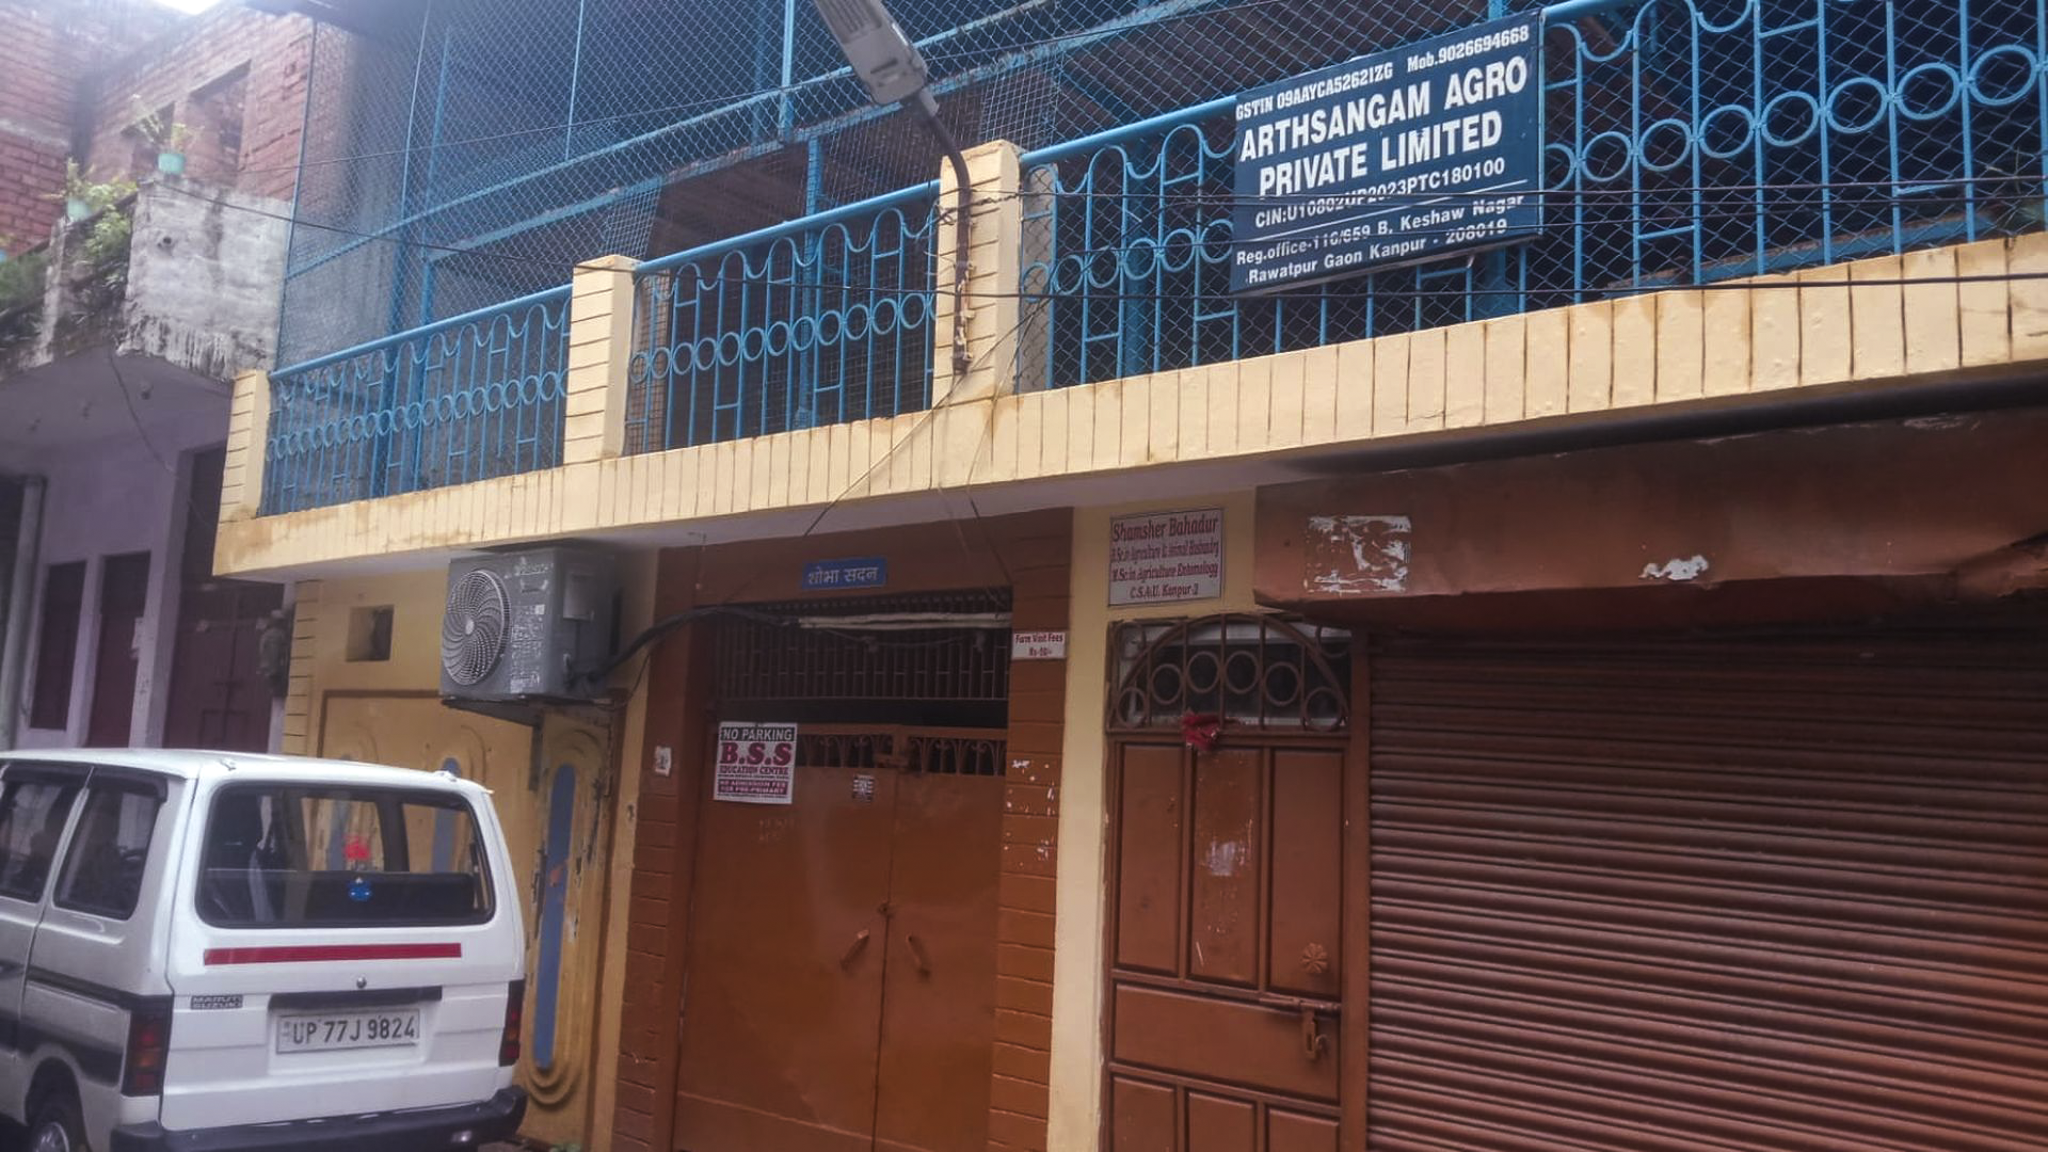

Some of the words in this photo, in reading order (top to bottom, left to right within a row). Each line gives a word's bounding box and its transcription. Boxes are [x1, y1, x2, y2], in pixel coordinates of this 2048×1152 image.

[1236, 95, 1273, 121] GSTIN
[1407, 25, 1530, 73] Mob.9026694668
[1240, 81, 1431, 162] ARTHSANGAM
[1444, 55, 1528, 110] AGRO
[1260, 142, 1367, 199] PRIVATE
[1382, 110, 1502, 171] LIMITED
[1378, 220, 1393, 235] B.
[1400, 206, 1465, 231] Keshaw
[1473, 195, 1525, 217] Nagar
[1248, 260, 1317, 284] Rawatpur
[1324, 251, 1362, 269] Gaon
[1370, 238, 1426, 260] Kanpur
[1445, 218, 1507, 244] 208019
[1112, 519, 1167, 543] Shamsher
[1169, 514, 1218, 537] Bahadur
[844, 566, 879, 582] सदन
[722, 728, 739, 740] NO
[742, 728, 792, 740] PARKING
[720, 742, 793, 766] B.S.S
[719, 765, 758, 774] EDUCATION
[759, 766, 789, 775] CENTRE
[293, 1021, 317, 1045] UP
[368, 1015, 415, 1040] 9824
